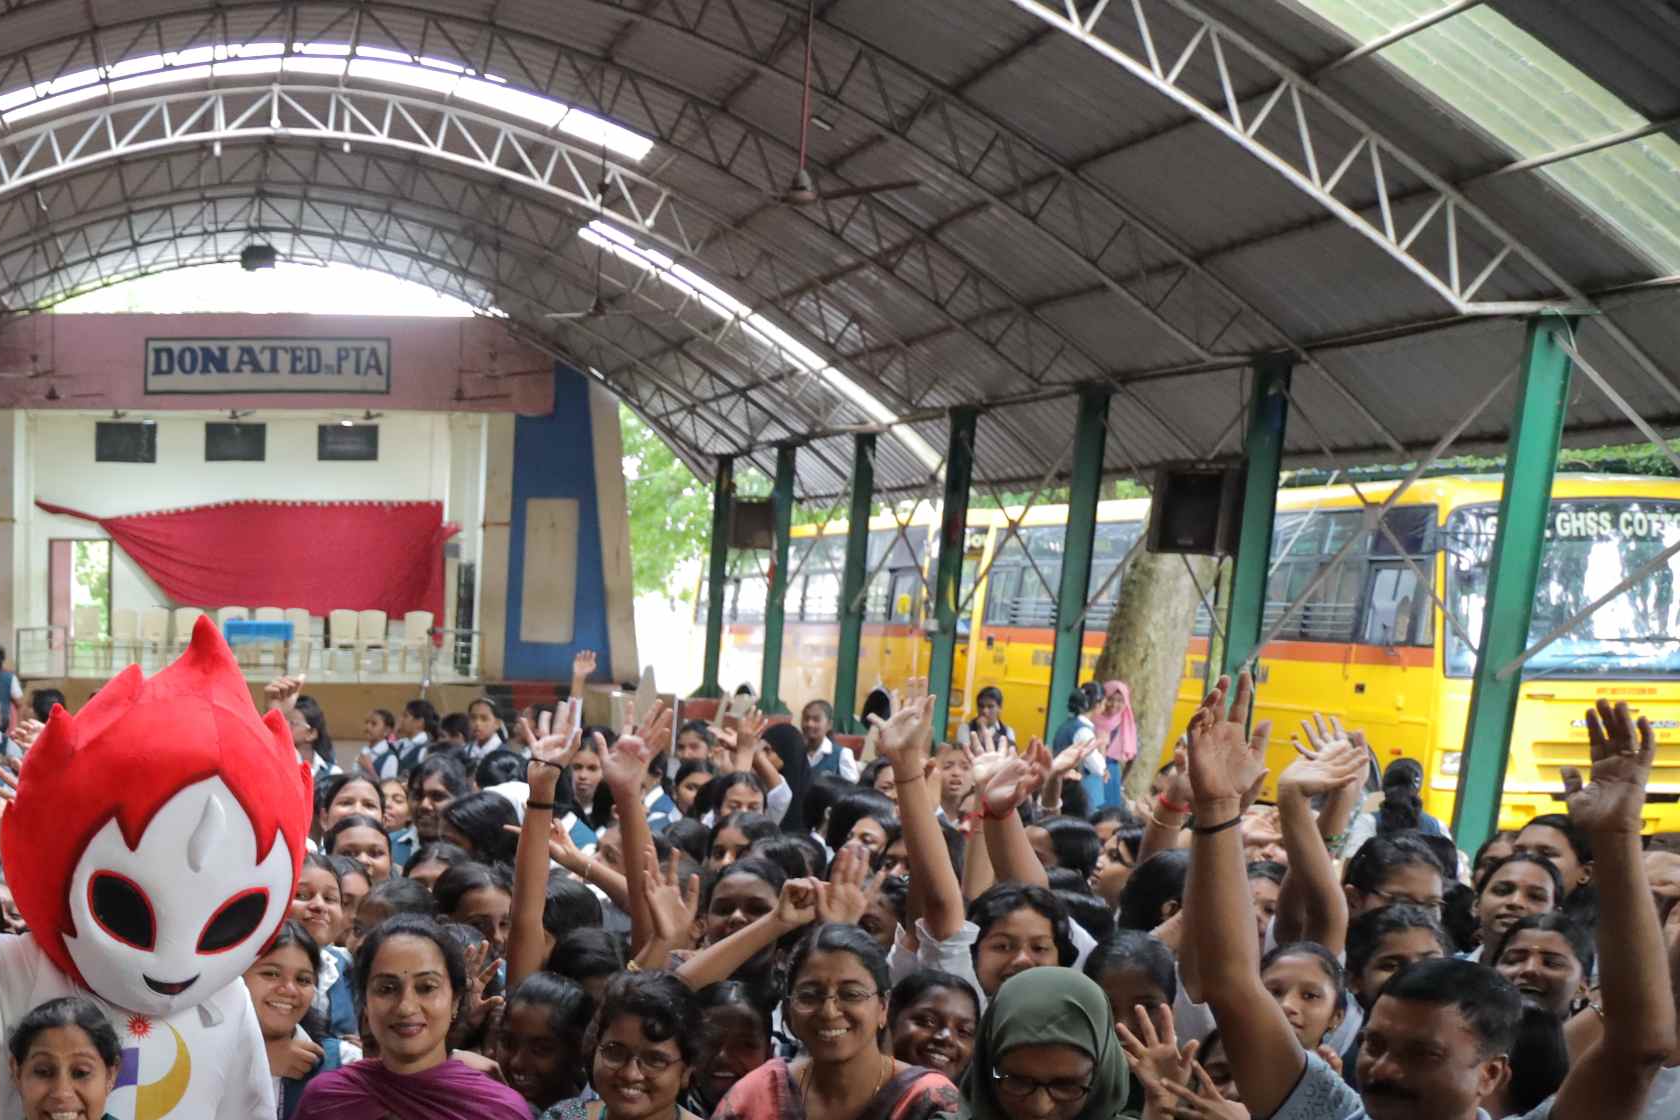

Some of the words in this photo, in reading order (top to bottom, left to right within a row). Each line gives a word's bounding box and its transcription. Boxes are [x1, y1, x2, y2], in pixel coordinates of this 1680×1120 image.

[151, 346, 322, 375] DONATED
[335, 346, 384, 376] PTA
[1555, 511, 1612, 537] GHSS
